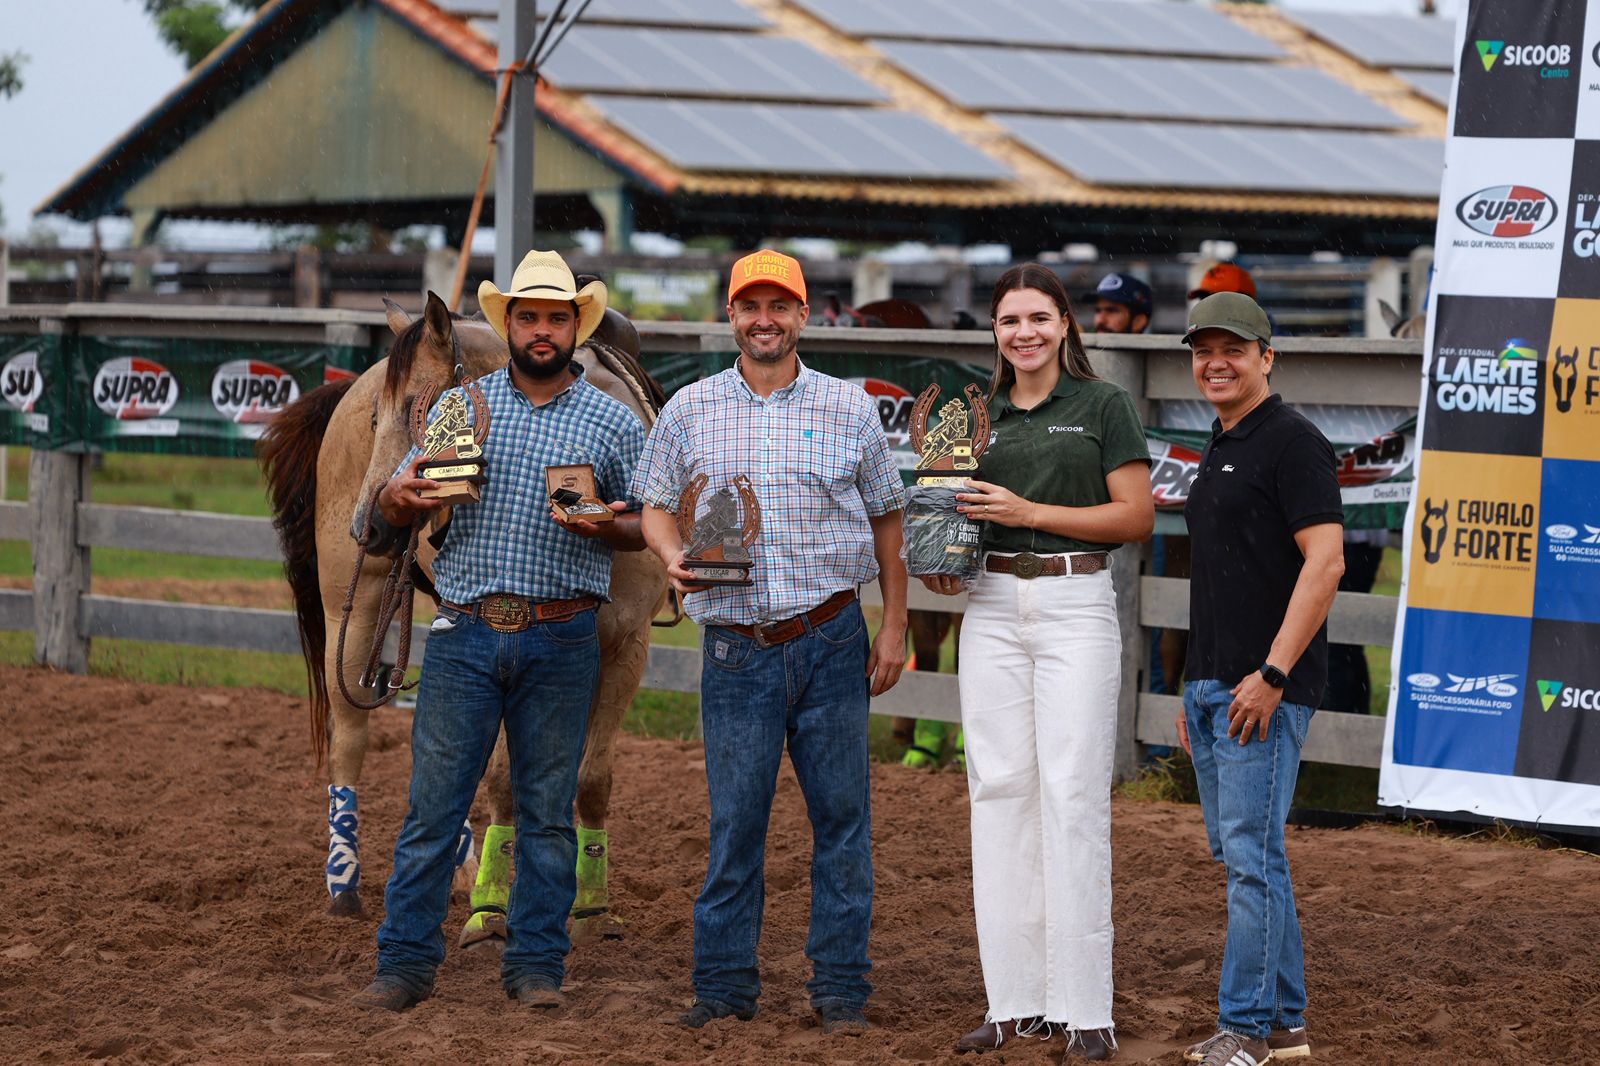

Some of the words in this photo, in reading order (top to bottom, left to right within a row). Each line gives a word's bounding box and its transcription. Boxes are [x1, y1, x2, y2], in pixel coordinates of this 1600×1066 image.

[1504, 44, 1571, 66] SICOOB
[1541, 67, 1569, 78] Centro
[1468, 200, 1546, 222] SUPRA
[1453, 240, 1469, 248] MAIS
[1471, 240, 1483, 248] QUE
[756, 263, 790, 279] FORTE
[1459, 348, 1496, 357] ESTADUAL
[1436, 356, 1538, 386] LAERTE
[98, 374, 171, 404] SUPRA
[217, 377, 292, 408] SUPRA
[1436, 382, 1537, 415] GOMES
[1457, 499, 1534, 528] CAVALO
[958, 531, 979, 544] FORTE
[1454, 527, 1533, 562] FORTE
[1410, 692, 1427, 701] SUA
[1428, 694, 1492, 708] CONCESSIONÁRIA
[1493, 700, 1513, 710] FORD
